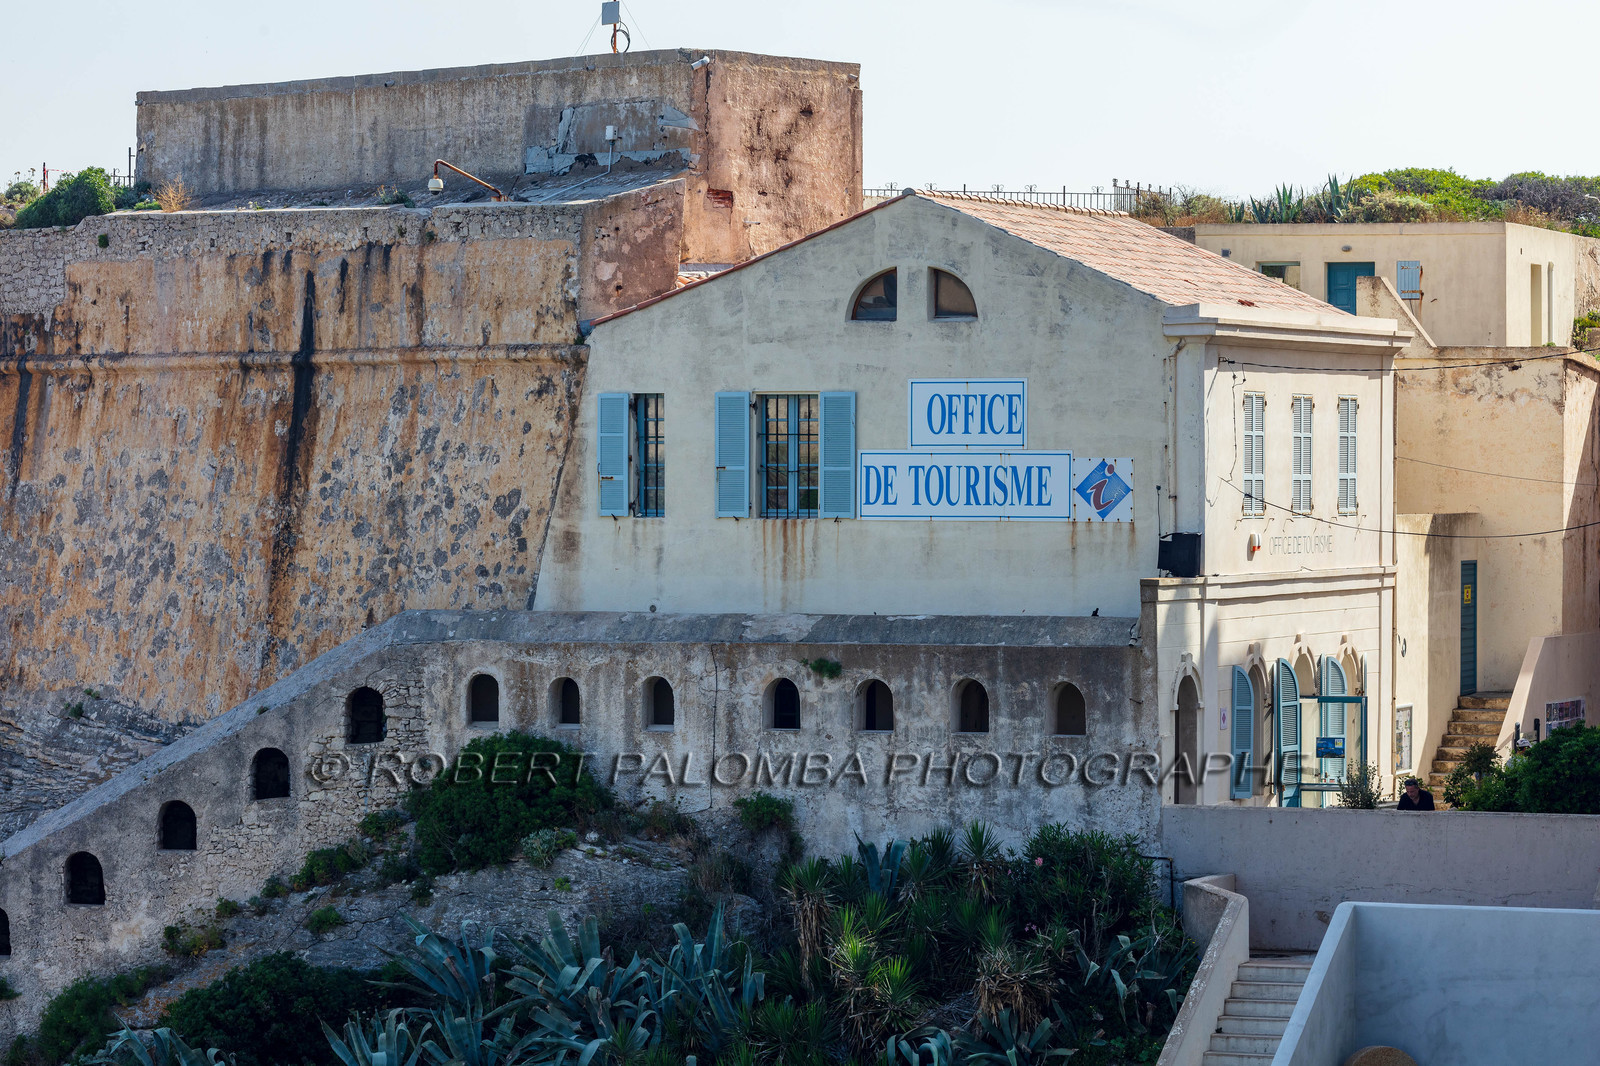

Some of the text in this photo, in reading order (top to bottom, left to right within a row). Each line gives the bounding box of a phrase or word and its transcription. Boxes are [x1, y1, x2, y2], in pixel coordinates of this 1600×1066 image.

[927, 394, 1022, 434] OFFICE
[863, 464, 1052, 506] DE TOURISME
[1269, 535, 1333, 555] OFFICE DE TOURISME
